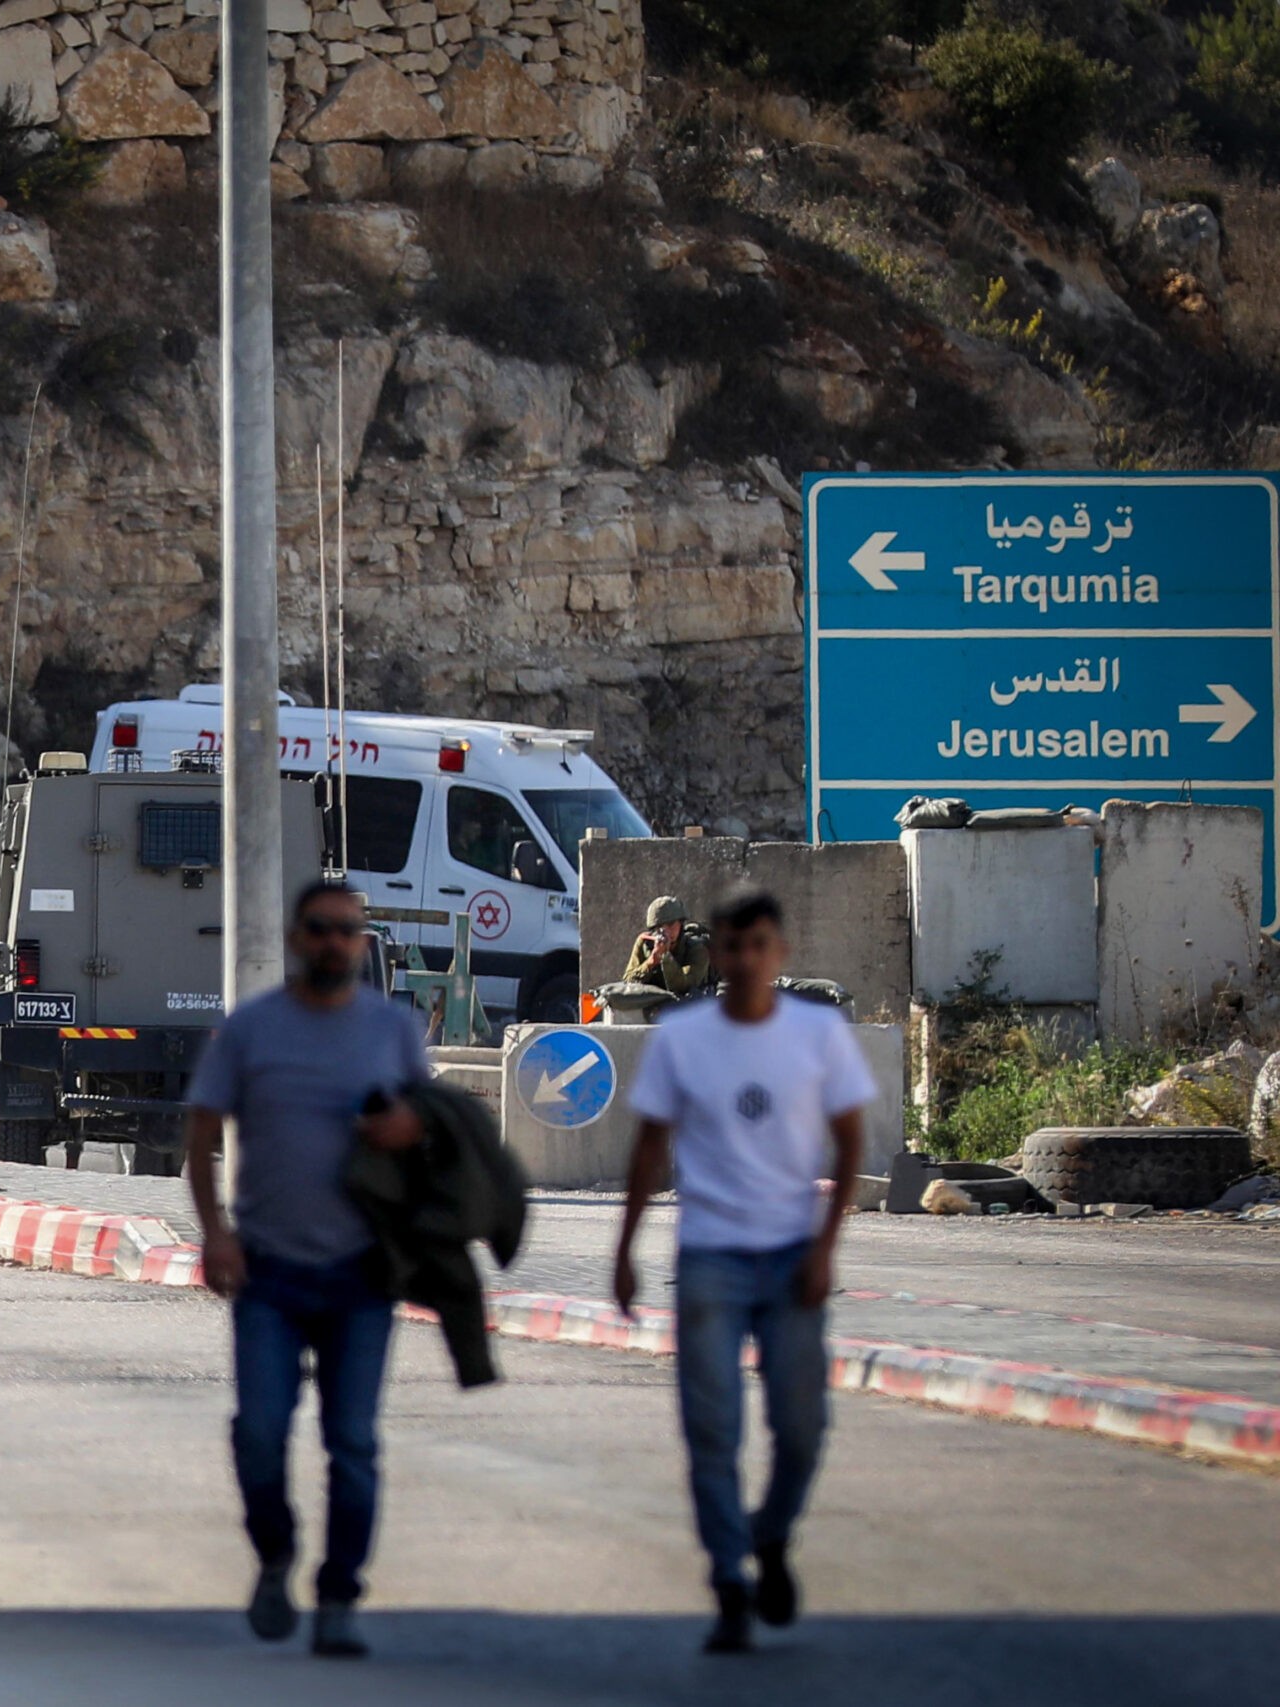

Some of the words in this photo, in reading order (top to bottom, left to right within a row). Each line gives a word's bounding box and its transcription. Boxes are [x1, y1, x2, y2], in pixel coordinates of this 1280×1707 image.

[986, 502, 1134, 553] ترقوميا
[953, 566, 1160, 613] Tarqumia
[990, 656, 1121, 706] القدس
[330, 734, 380, 764] חיל
[937, 720, 1170, 758] Jerusalem
[167, 1000, 224, 1010] 02-56942
